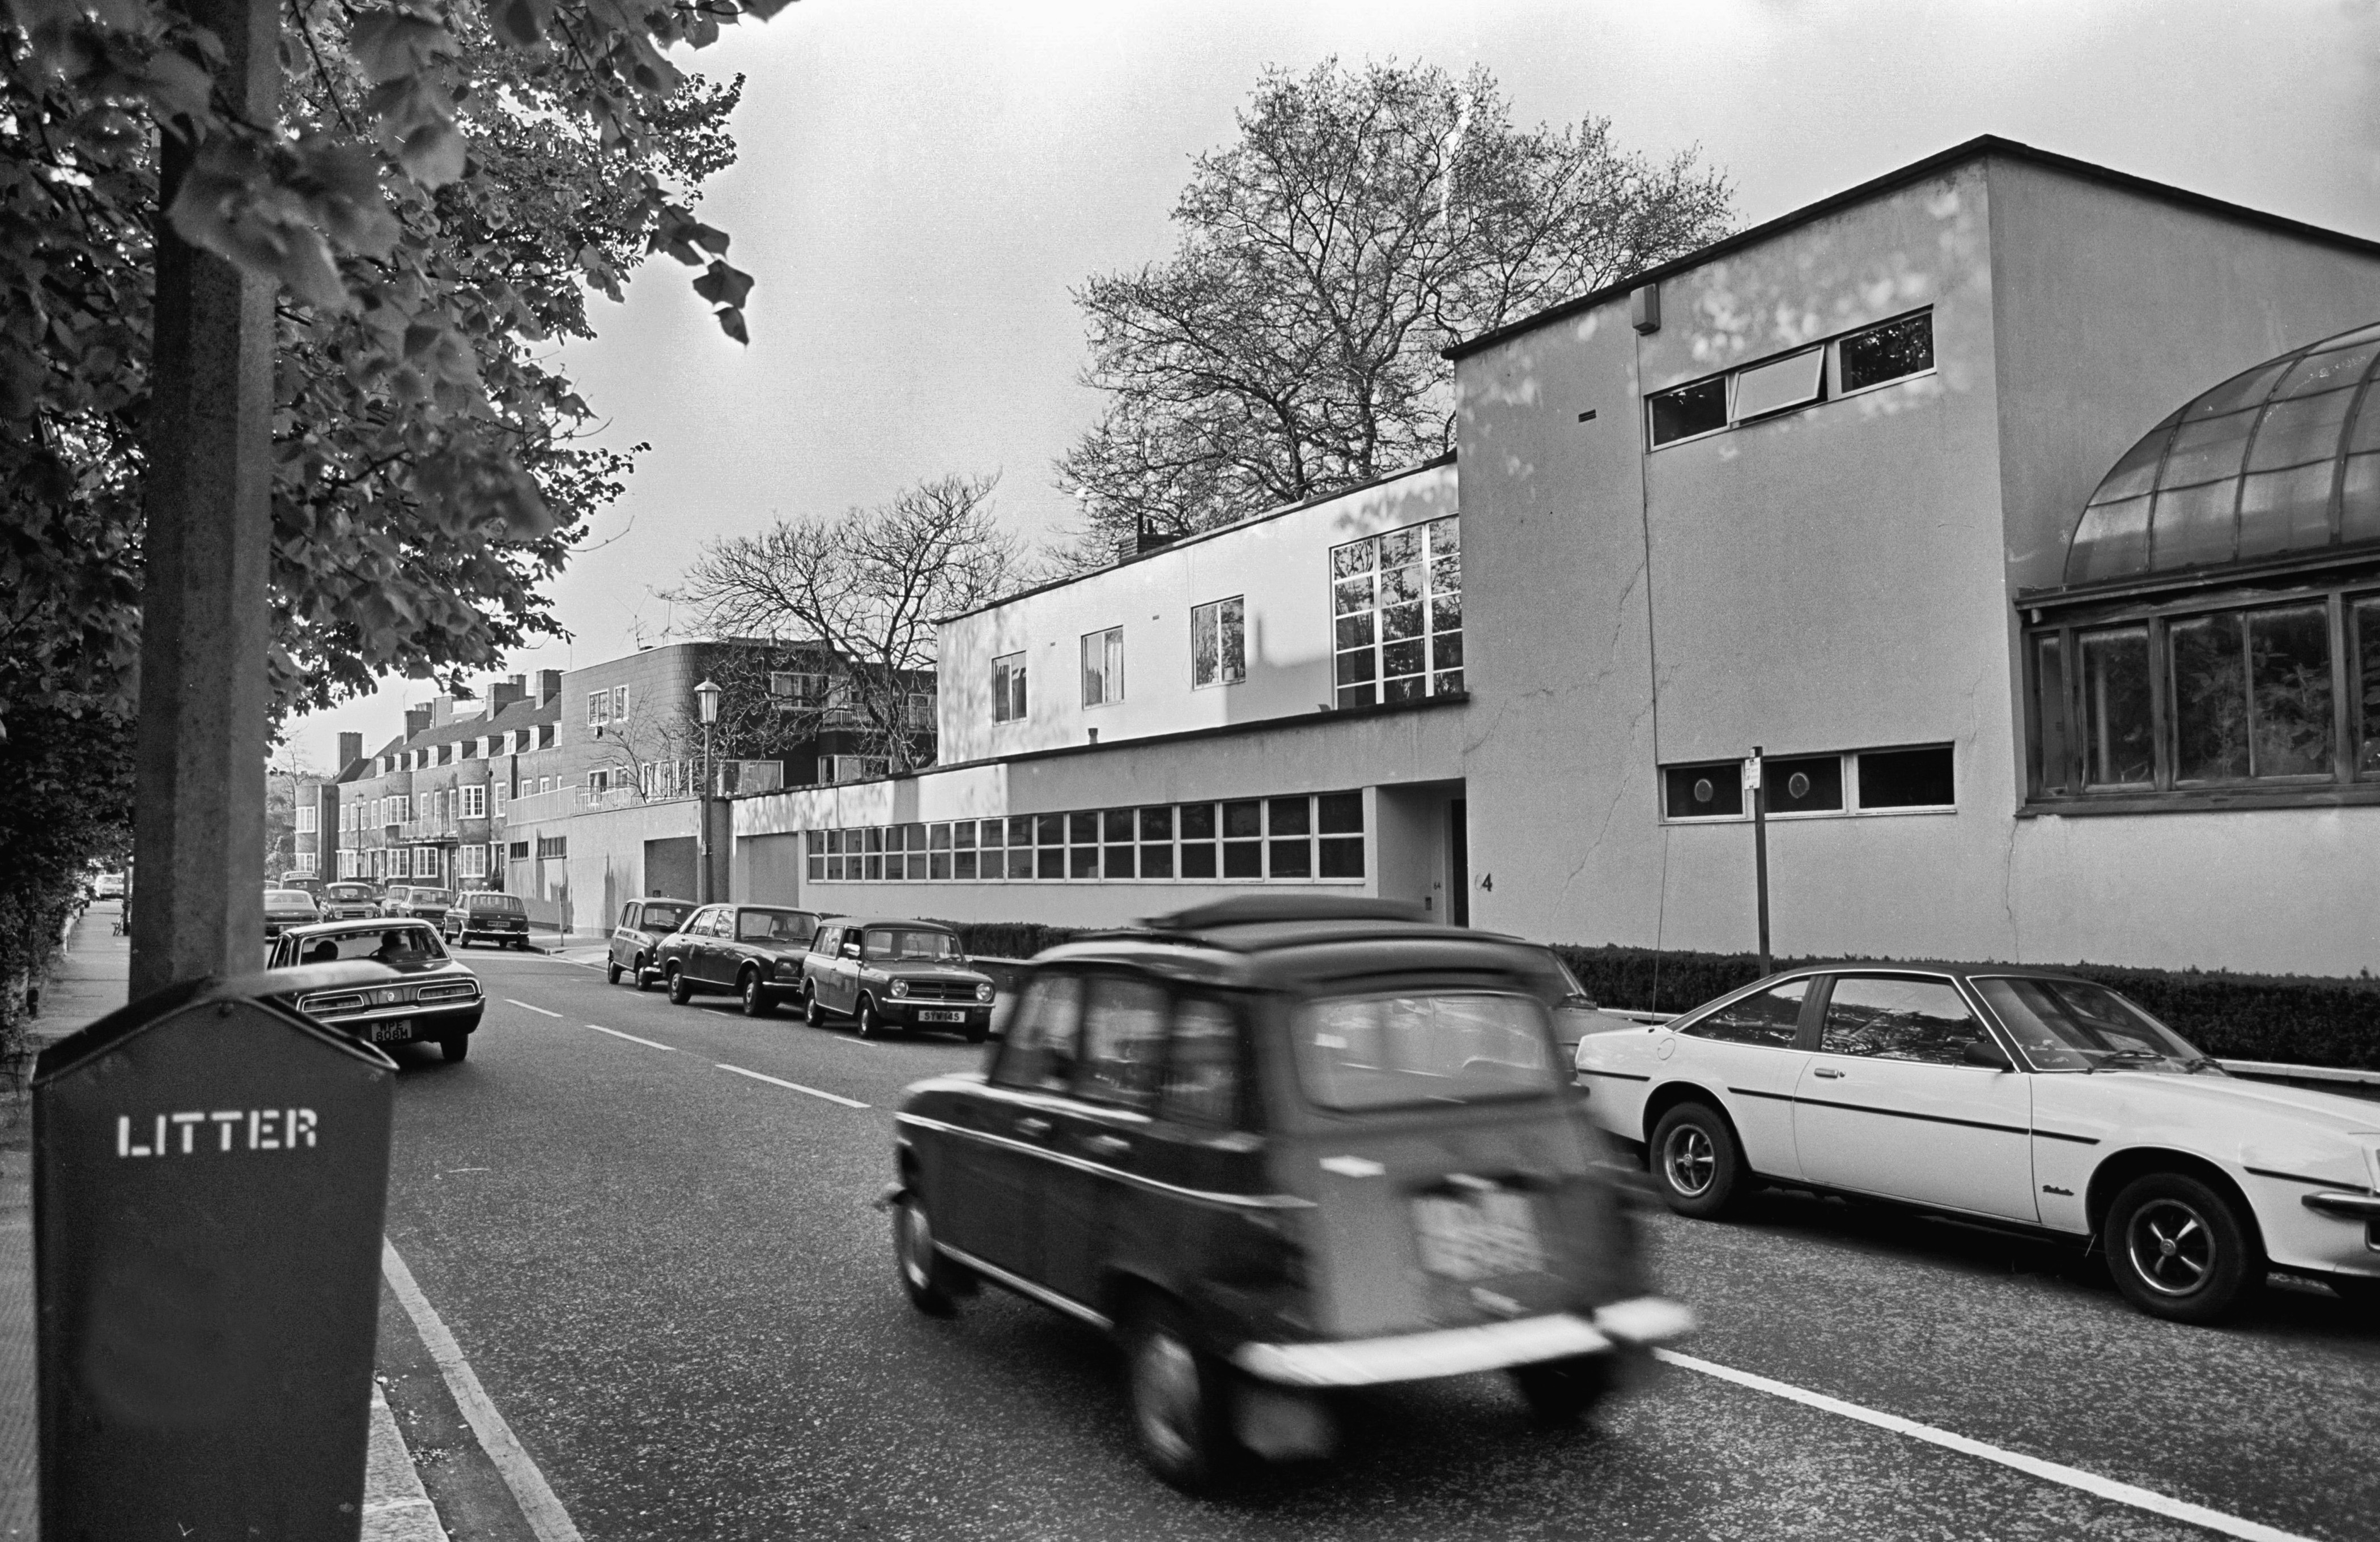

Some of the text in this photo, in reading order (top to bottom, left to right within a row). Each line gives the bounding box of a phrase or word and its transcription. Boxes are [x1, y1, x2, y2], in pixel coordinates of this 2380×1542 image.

[377, 1020, 403, 1032] WPE
[376, 1029, 408, 1041] 808M
[118, 1109, 317, 1157] LITTER
